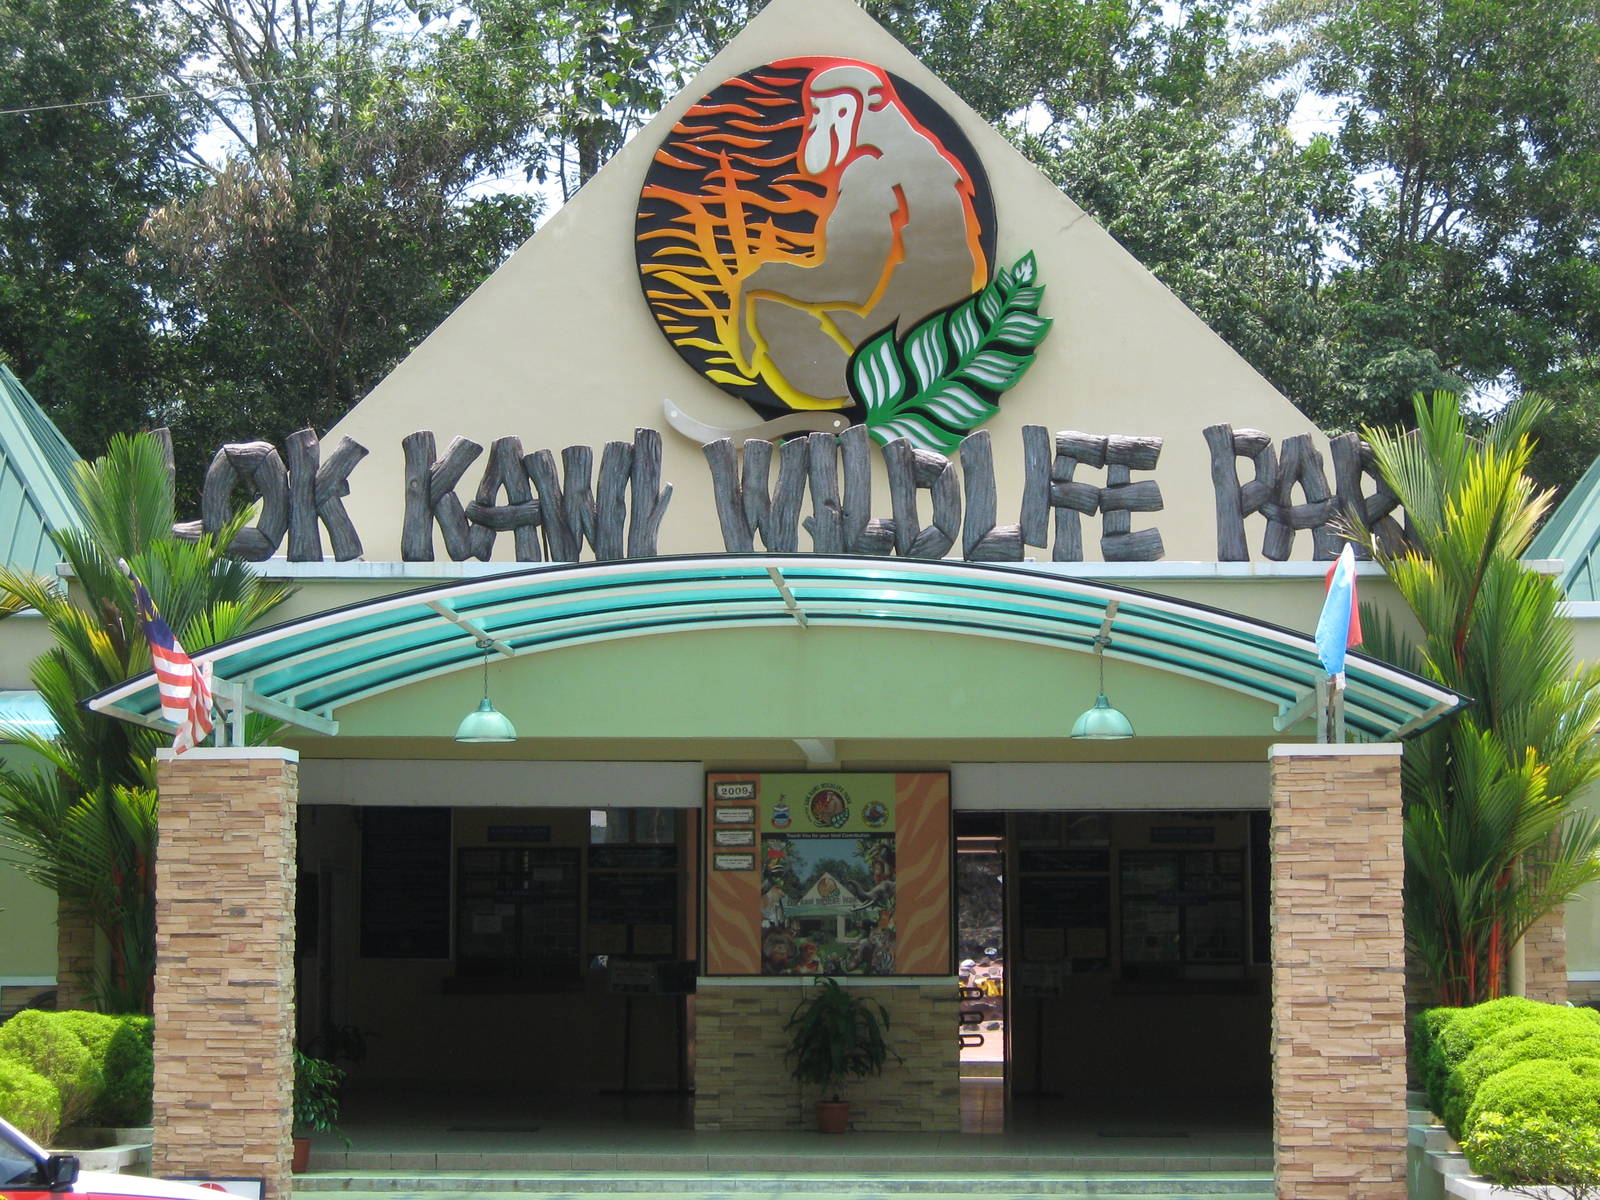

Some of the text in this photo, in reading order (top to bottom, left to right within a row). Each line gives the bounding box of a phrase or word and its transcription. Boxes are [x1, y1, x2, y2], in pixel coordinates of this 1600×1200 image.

[402, 427, 673, 562] KAWI
[702, 424, 1165, 562] WILDLIFE
[720, 786, 749, 796] 2009
